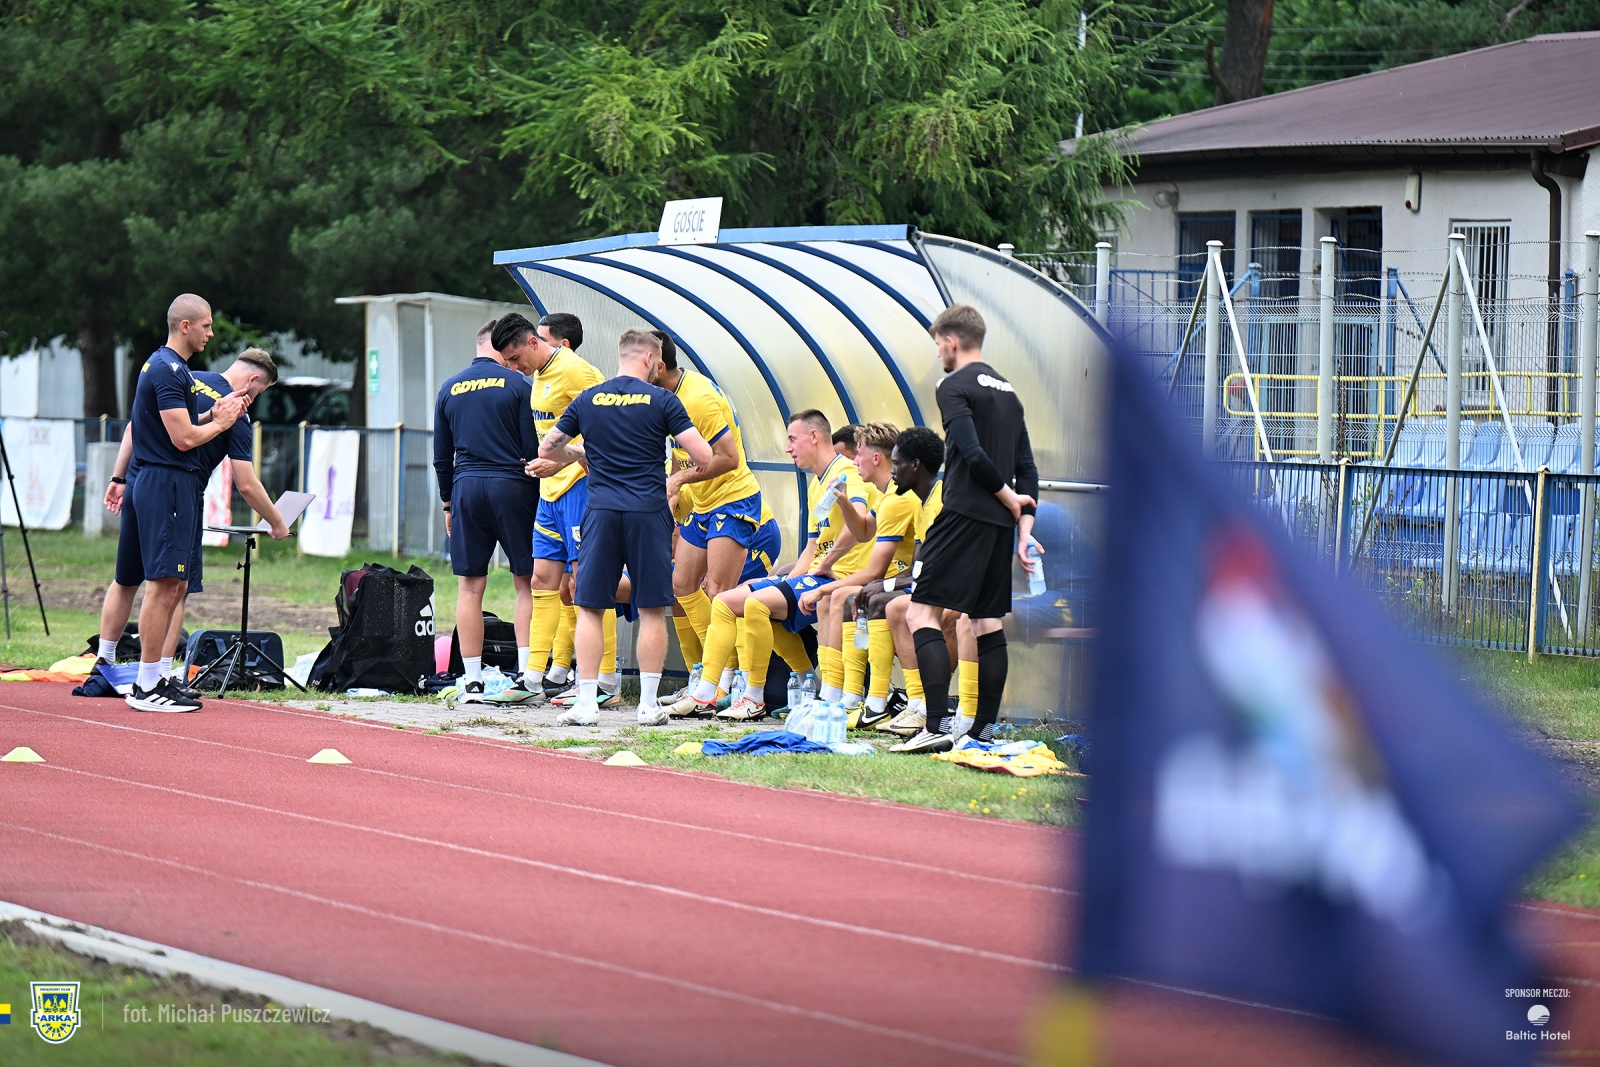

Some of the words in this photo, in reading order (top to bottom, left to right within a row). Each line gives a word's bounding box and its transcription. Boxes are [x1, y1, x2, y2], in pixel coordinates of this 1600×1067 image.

[673, 205, 706, 233] GOŚCIE
[450, 377, 506, 396] GDYNIA
[591, 392, 652, 407] GDYNIA
[414, 619, 436, 637] ad
